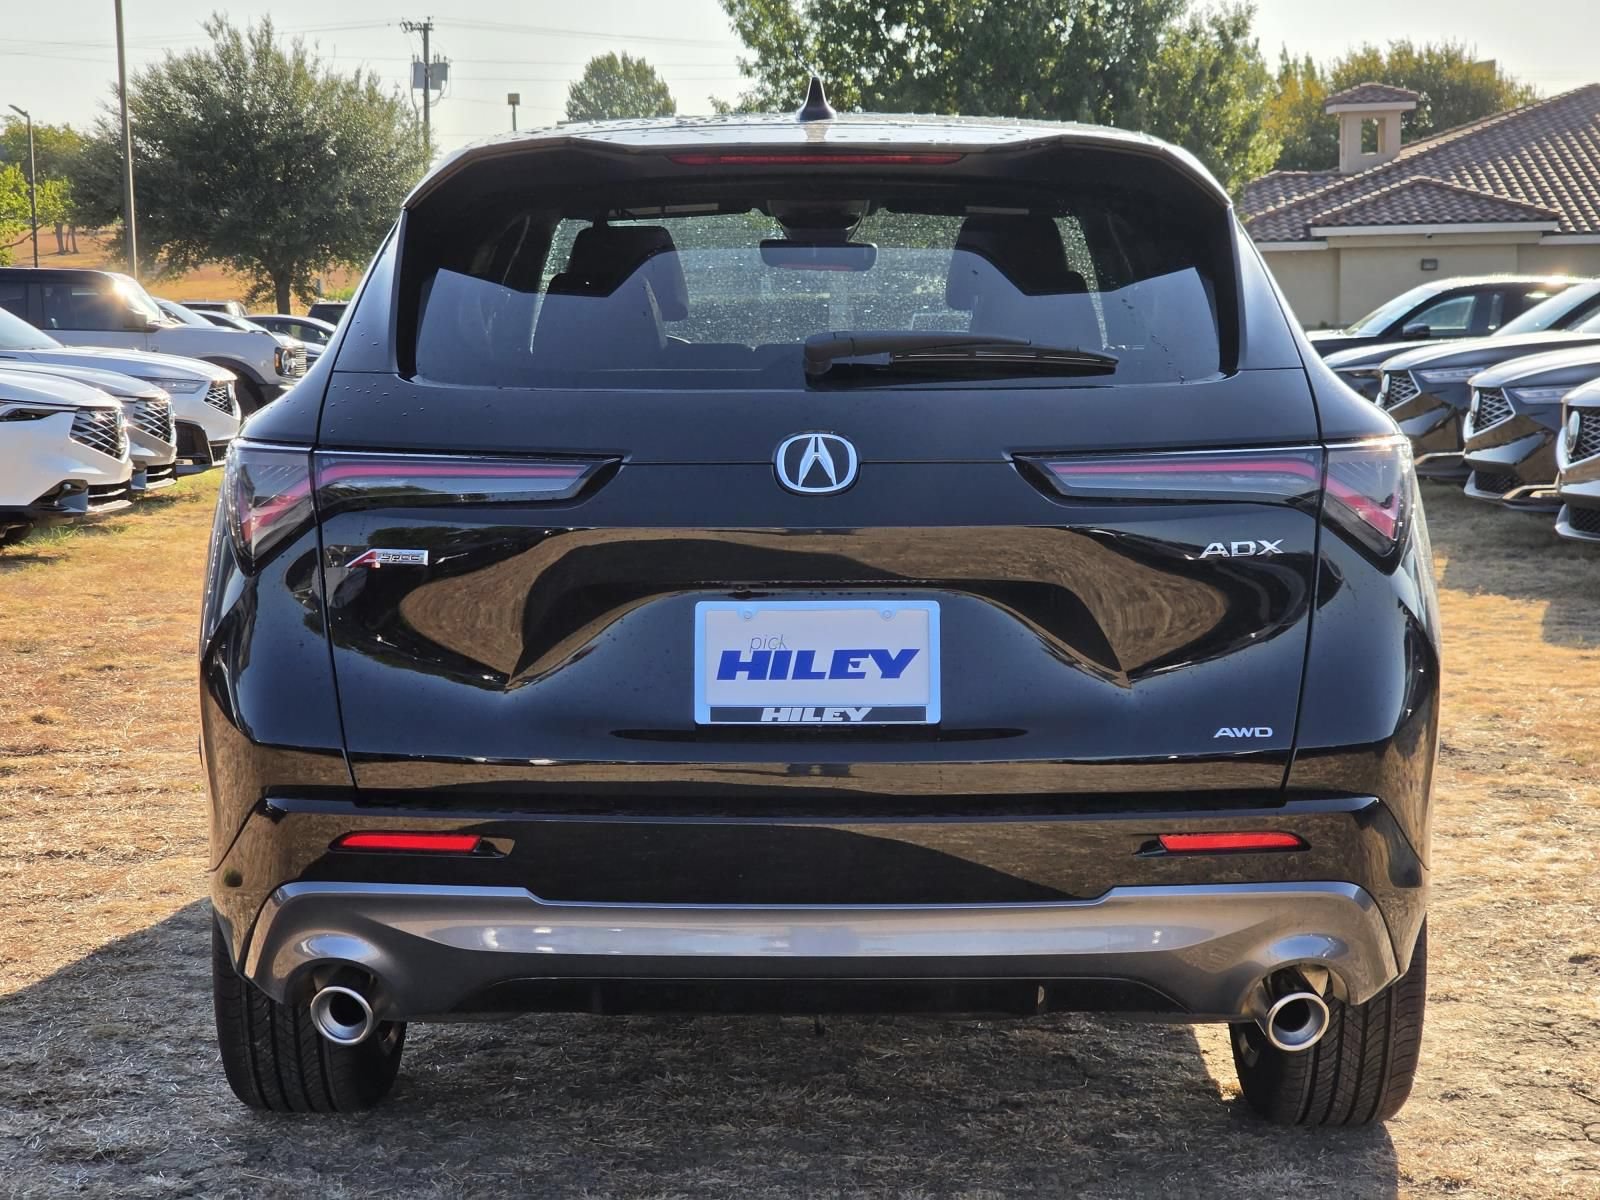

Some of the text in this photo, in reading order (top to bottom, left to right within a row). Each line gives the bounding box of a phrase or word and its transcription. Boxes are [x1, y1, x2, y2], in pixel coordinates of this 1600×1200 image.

[1199, 539, 1284, 559] ADX
[750, 634, 788, 652] pick
[716, 649, 920, 681] HILEY
[760, 707, 872, 722] HILEY
[1213, 727, 1274, 739] AWD
